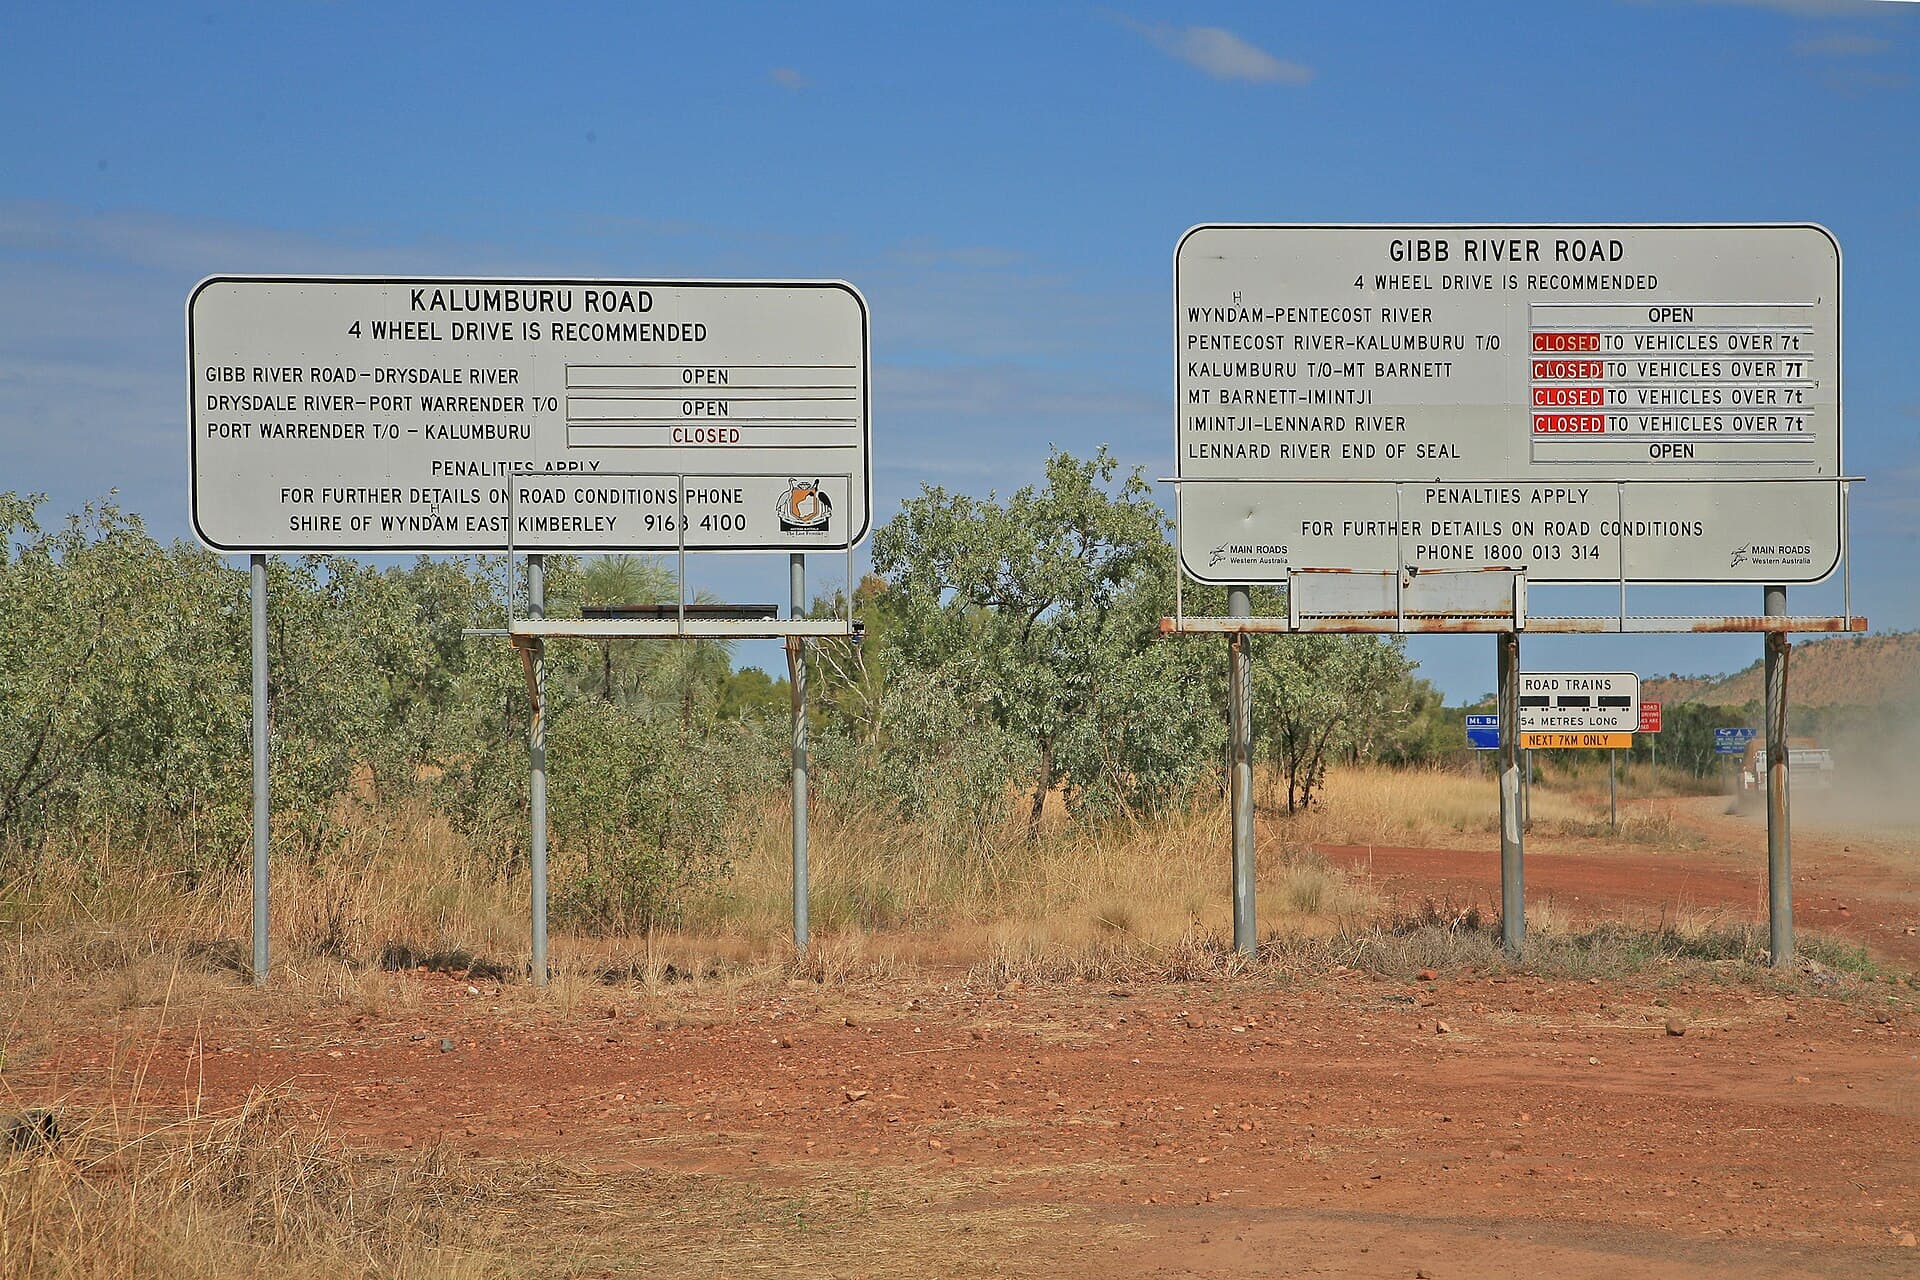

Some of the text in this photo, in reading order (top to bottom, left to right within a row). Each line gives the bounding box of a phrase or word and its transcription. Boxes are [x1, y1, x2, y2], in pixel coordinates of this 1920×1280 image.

[1391, 240, 1623, 261] GIBB RIVER ROAD
[1354, 275, 1657, 289] 4 WHEEL DRIVE IS RECOMMENDED
[412, 289, 652, 312] KALUMBURU ROAD
[1382, 308, 1431, 322] RIVER
[1649, 308, 1693, 322] OPEN
[349, 321, 706, 341] 4 WHEEL DRIVE IS RECOMMENDED
[1189, 335, 1284, 349] PENTECOST
[1534, 335, 1799, 350] CLOSED TO VEHICLES OVER 7t
[206, 367, 245, 381] GIBB
[254, 368, 302, 382] RIVER
[470, 369, 518, 383] RIVER
[683, 369, 727, 384] OPEN
[1189, 363, 1295, 377] KALUMBURU
[1376, 363, 1451, 377] BARNETT
[1534, 362, 1802, 377] CLOSED TO VEHICLES OVER 7T
[208, 396, 296, 410] DRYSDALE
[421, 397, 523, 411] WARRENDER
[1190, 390, 1210, 403] MT
[1536, 390, 1802, 404] CLOSED TO VEHICLES OVER 7t
[683, 402, 727, 415] OPEN
[1356, 417, 1404, 431] RIVER
[1536, 417, 1802, 432] CLOSED TO VEHICLES OVER 7t
[208, 424, 251, 438] PORT
[260, 424, 364, 438] WARRENDER
[426, 425, 530, 439] KALUMBURU
[673, 428, 739, 443] CLOSED
[1190, 444, 1460, 458] LENNARD RIVER END OF SEAL
[1650, 444, 1693, 458] OPEN
[432, 461, 533, 476] PENALITIES
[282, 489, 742, 504] FOR FURTHER DETAILS ON ROAD CONDITIONS PHONE
[1427, 489, 1588, 503] PENALTIES APPLY
[290, 516, 341, 530] SHIRE
[351, 517, 372, 530] OF
[467, 517, 509, 531] EAST
[519, 517, 616, 531] KIMBERLEY
[700, 515, 745, 530] 4100
[1303, 522, 1702, 536] FOR FURTHER DETAILS ON ROAD CONDITIONS
[1417, 545, 1599, 559] PHONE 1800 013 314
[1752, 546, 1810, 554] MAIN ROADS
[1526, 680, 1611, 690] ROAD TRAINS
[1530, 735, 1608, 745] NEXT 7KM ONLY
